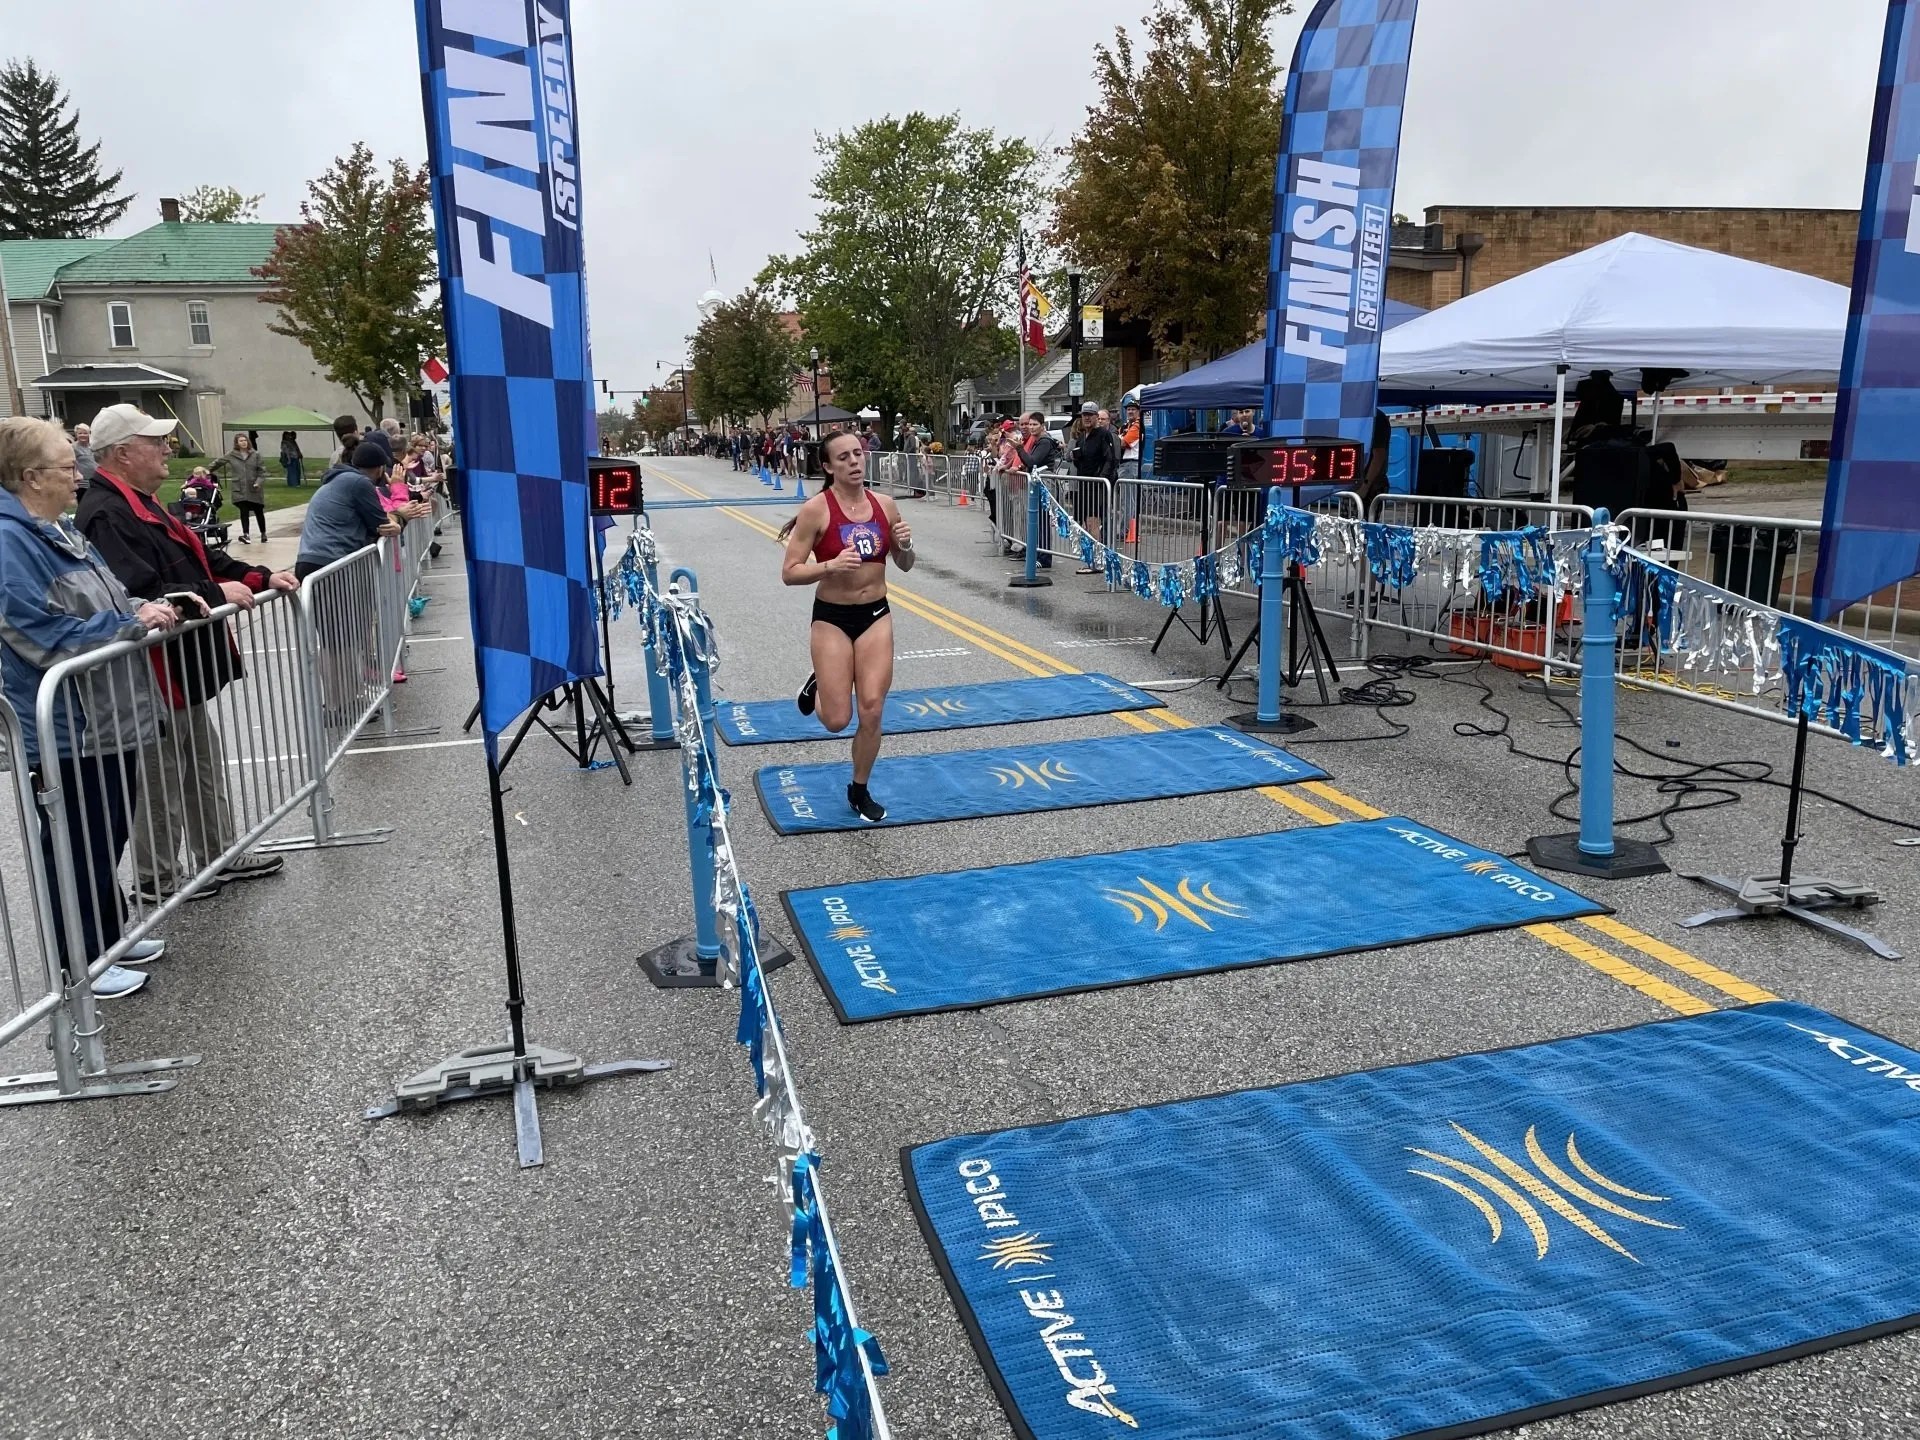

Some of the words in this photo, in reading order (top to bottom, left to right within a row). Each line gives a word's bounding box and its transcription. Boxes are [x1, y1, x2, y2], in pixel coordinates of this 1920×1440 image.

[538, 1, 578, 217] SPEEDY
[1284, 158, 1361, 365] FINISH
[1363, 209, 1384, 255] FEET
[1358, 254, 1380, 327] SPEEDY
[599, 471, 631, 508] 12
[1271, 448, 1356, 482] 35:13
[857, 539, 873, 555] 13
[1386, 826, 1468, 861] ACTIVE
[1490, 872, 1556, 902] IPICO
[822, 897, 855, 925] IPICO
[845, 944, 897, 994] ACTIVE
[958, 1158, 1020, 1229] IPICO
[1019, 1289, 1139, 1429] ACTIVE
